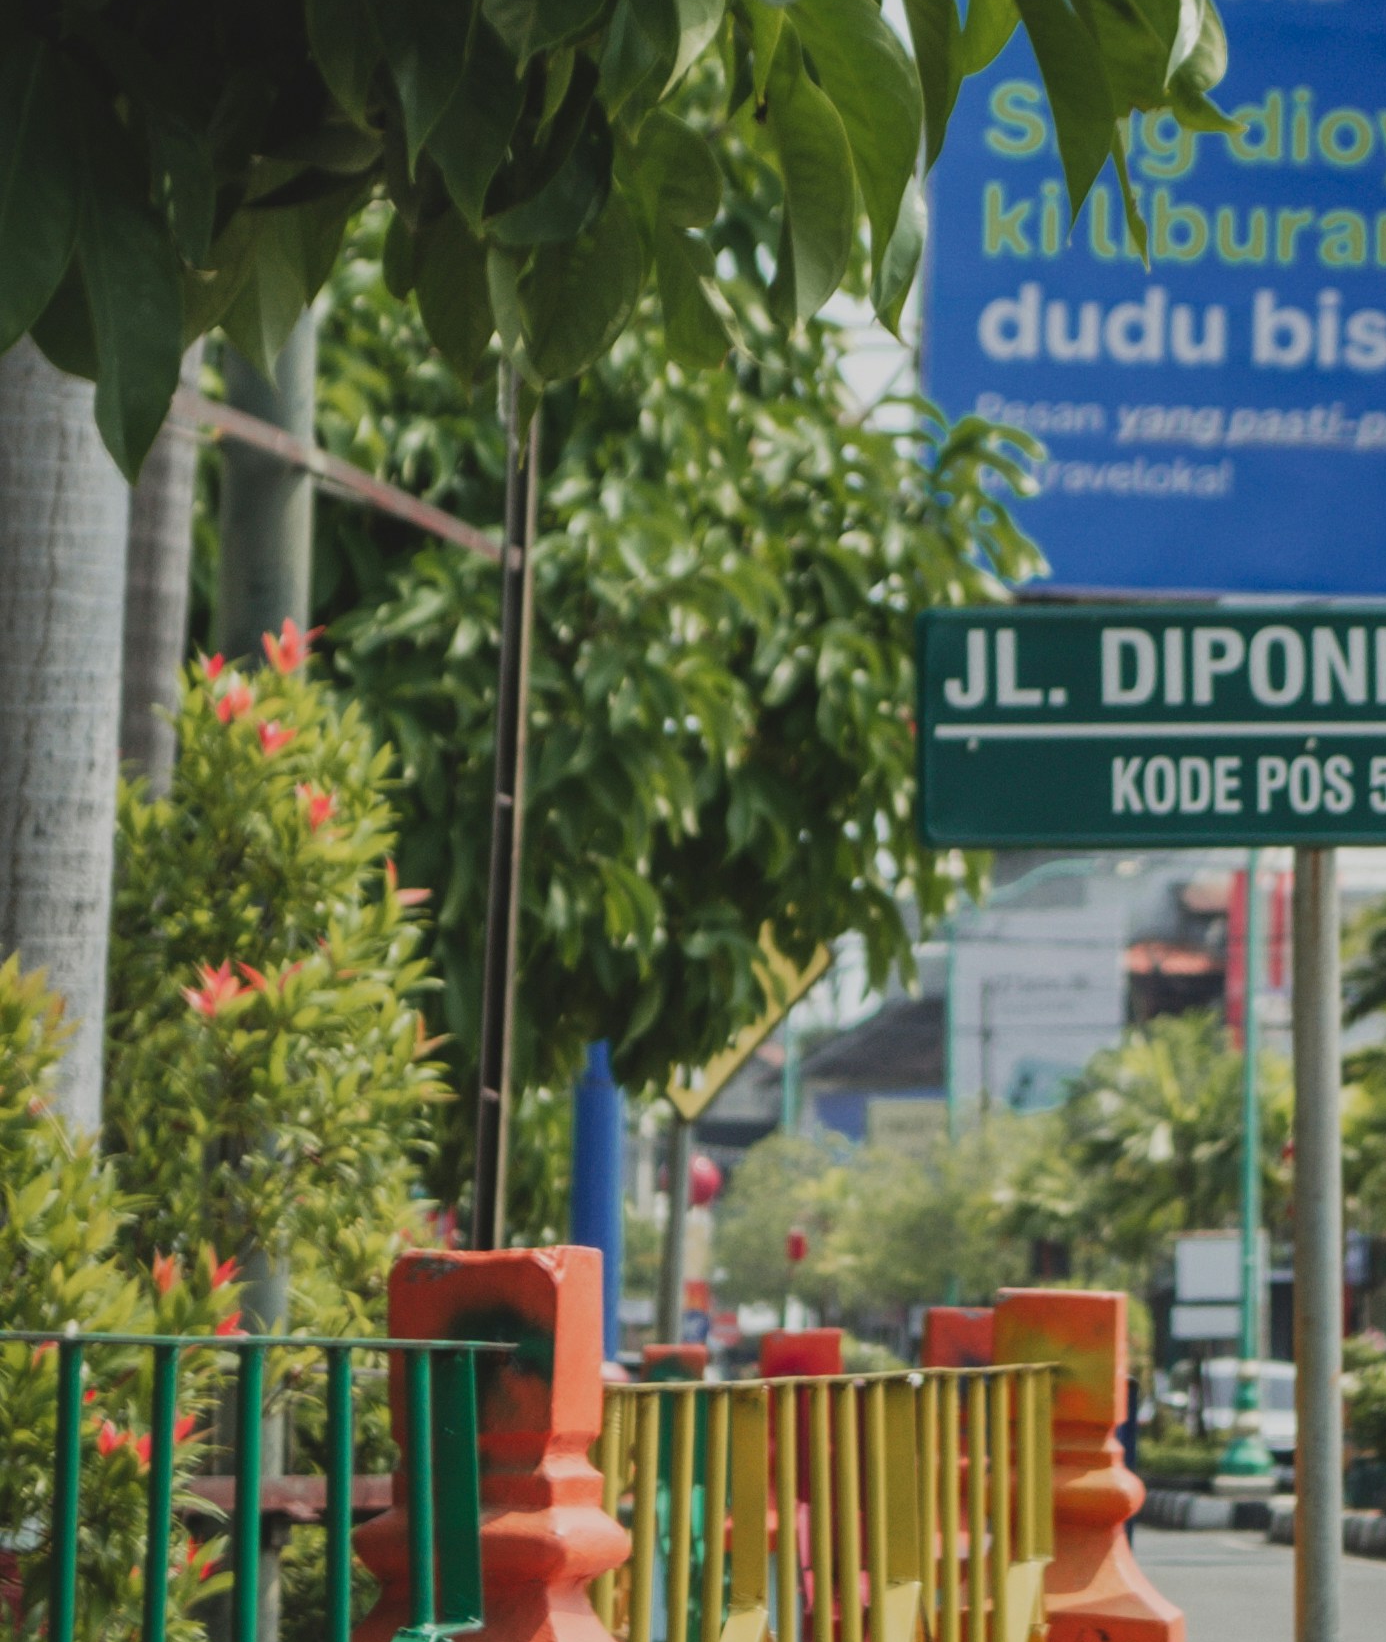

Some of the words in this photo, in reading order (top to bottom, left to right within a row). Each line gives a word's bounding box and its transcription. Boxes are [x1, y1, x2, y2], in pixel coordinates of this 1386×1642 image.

[983, 79, 1197, 179] Sg
[983, 180, 1062, 257] ki
[978, 282, 1226, 367] dudu
[1114, 403, 1222, 447] yang
[944, 628, 1068, 708] JL.
[1112, 756, 1243, 814] KODE
[1257, 756, 1355, 814] POS
